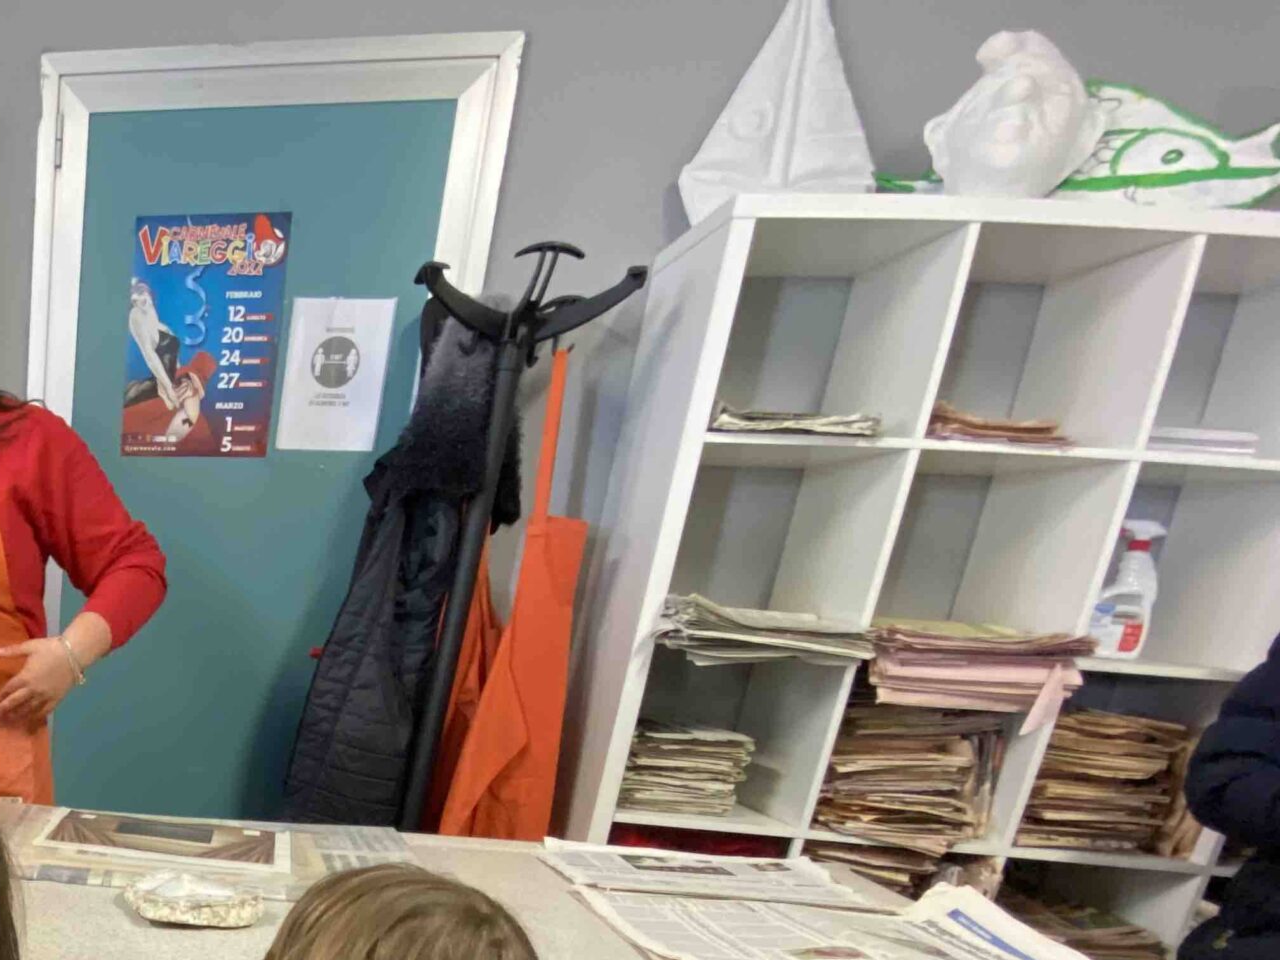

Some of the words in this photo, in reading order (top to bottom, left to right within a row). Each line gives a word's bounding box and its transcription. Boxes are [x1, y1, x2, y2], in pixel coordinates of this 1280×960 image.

[228, 305, 245, 322] 12
[221, 327, 244, 343] 20
[219, 349, 240, 366] 24
[217, 372, 240, 389] 27
[215, 401, 244, 410] MARZO
[225, 416, 233, 433] 1
[220, 436, 233, 452] 5
